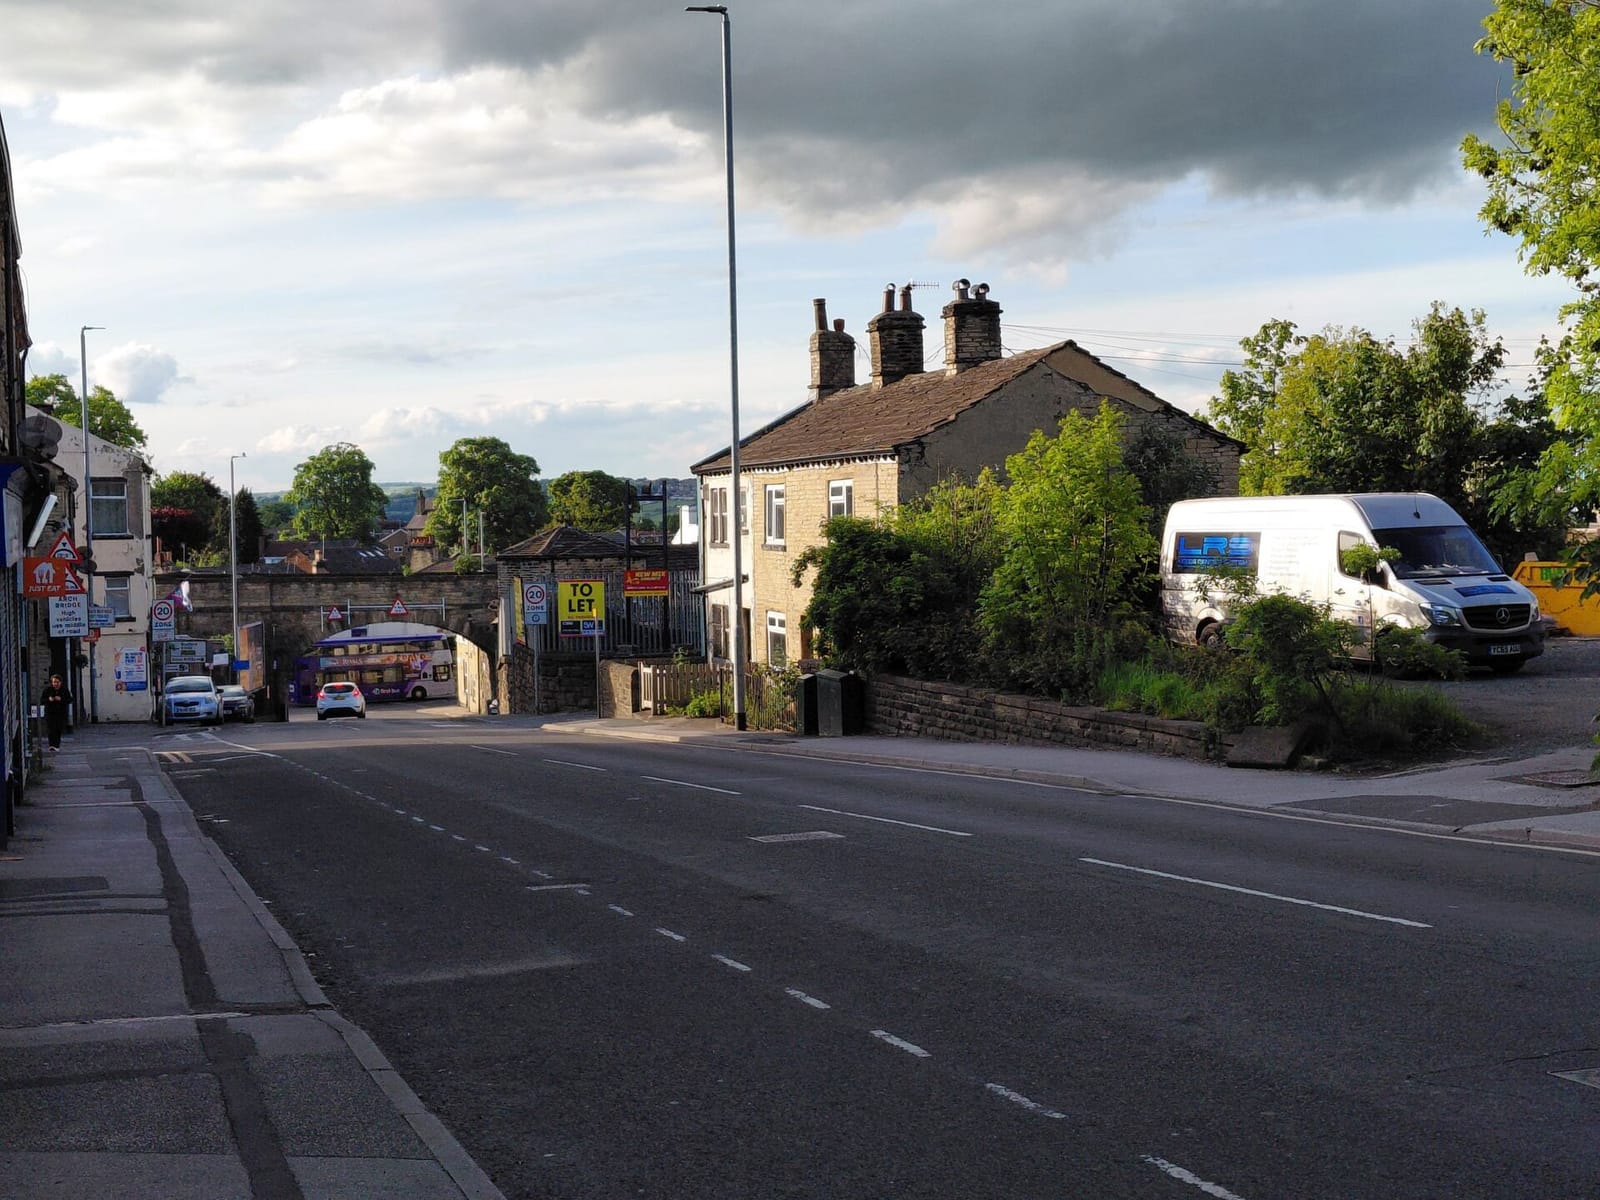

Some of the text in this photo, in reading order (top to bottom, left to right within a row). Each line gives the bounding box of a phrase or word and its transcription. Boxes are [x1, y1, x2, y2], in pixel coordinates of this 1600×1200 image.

[1178, 535, 1253, 556] LRS
[29, 585, 46, 593] JUST
[529, 590, 542, 599] 20
[570, 583, 593, 597] TO
[156, 607, 170, 616] 20
[568, 599, 595, 613] LET
